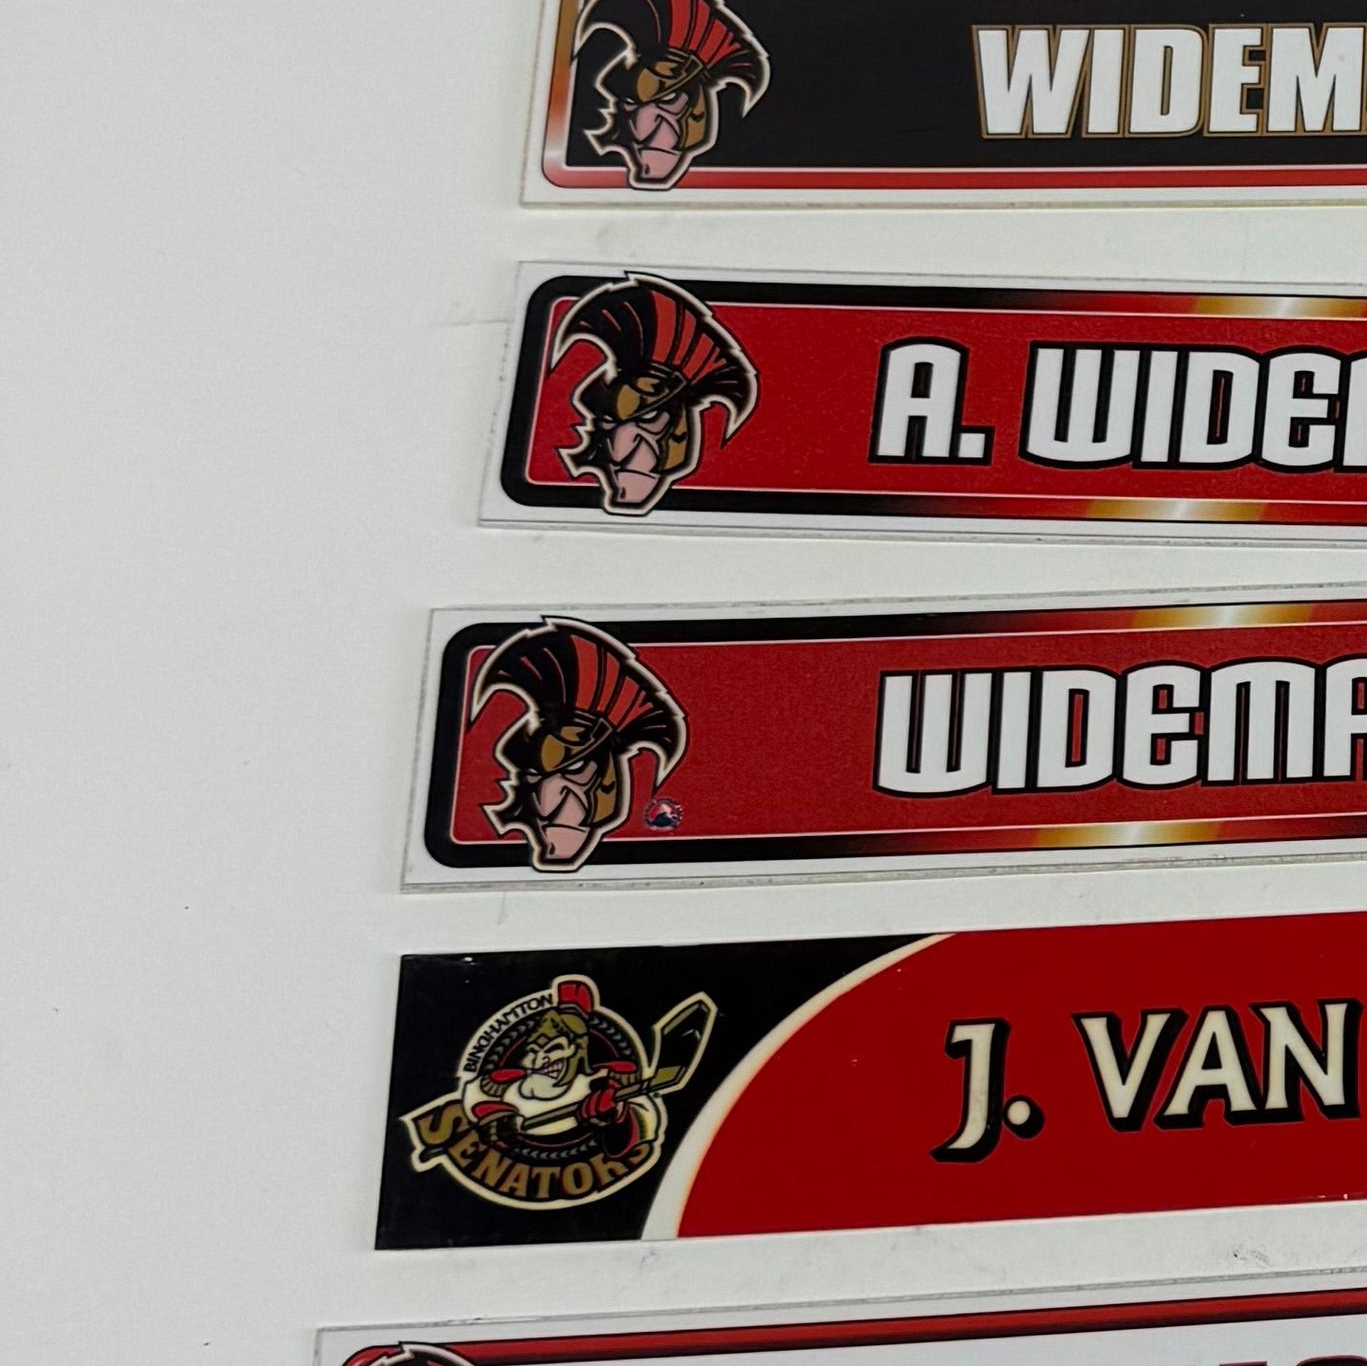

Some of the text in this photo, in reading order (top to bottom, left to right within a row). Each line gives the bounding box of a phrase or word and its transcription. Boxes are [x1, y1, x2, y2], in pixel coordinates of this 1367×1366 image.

[868, 336, 995, 467] A.
[929, 1019, 1045, 1164] J.
[1073, 998, 1363, 1130] VAN
